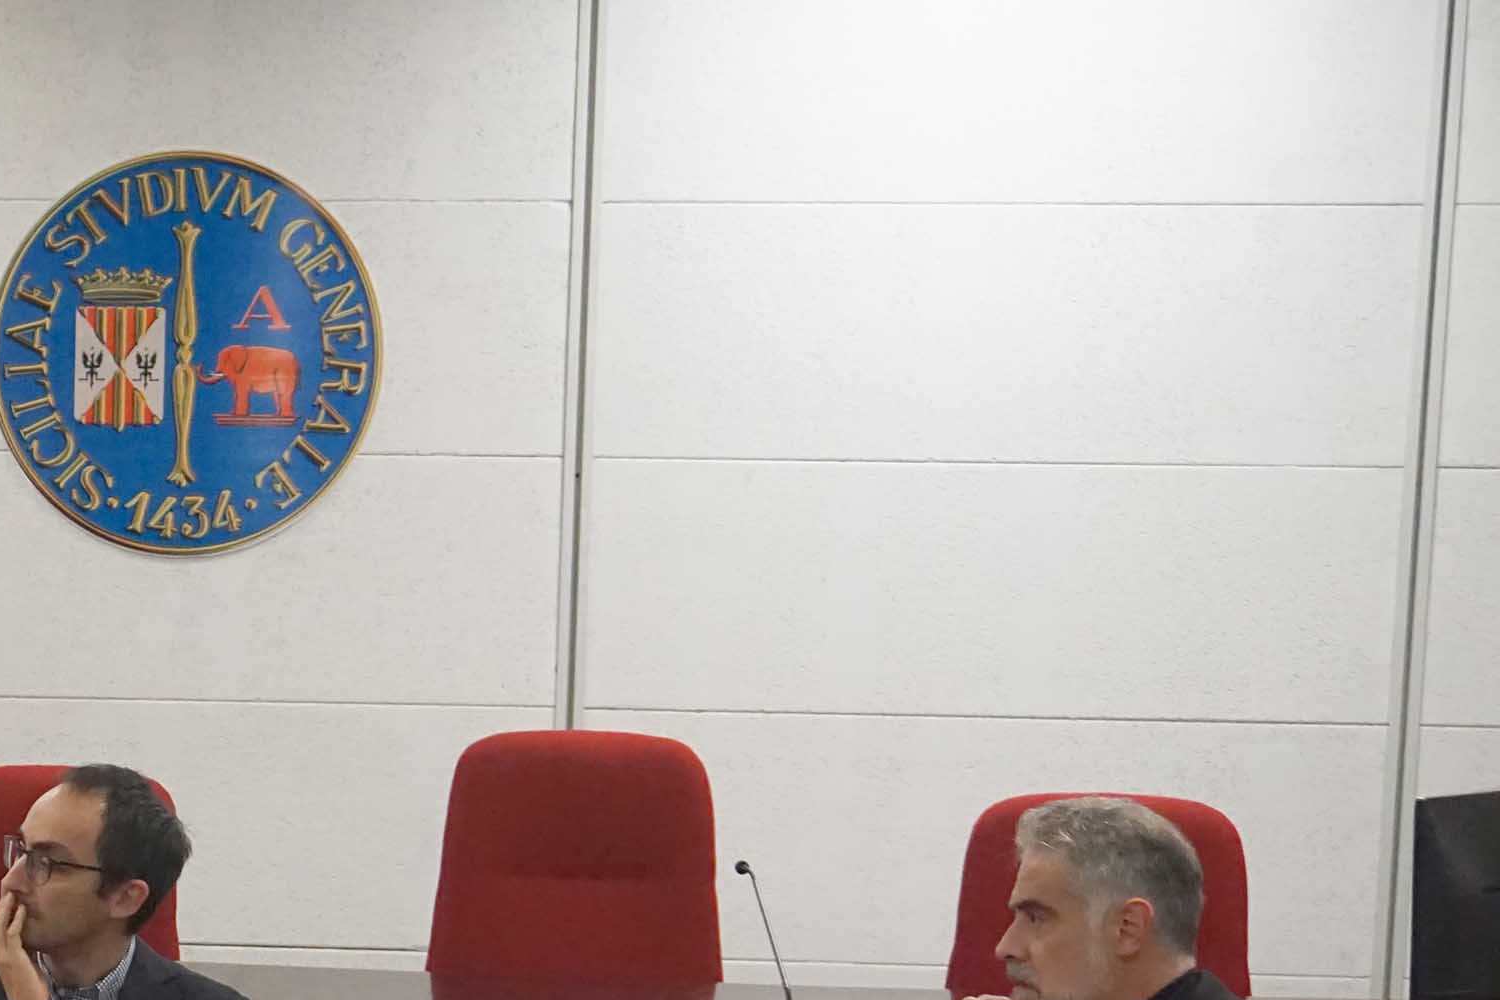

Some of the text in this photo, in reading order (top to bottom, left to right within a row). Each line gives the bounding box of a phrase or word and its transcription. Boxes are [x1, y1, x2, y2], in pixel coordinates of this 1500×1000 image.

[4, 167, 371, 511] SICILIAE STVDIVM GENERALE
[231, 285, 291, 330] A
